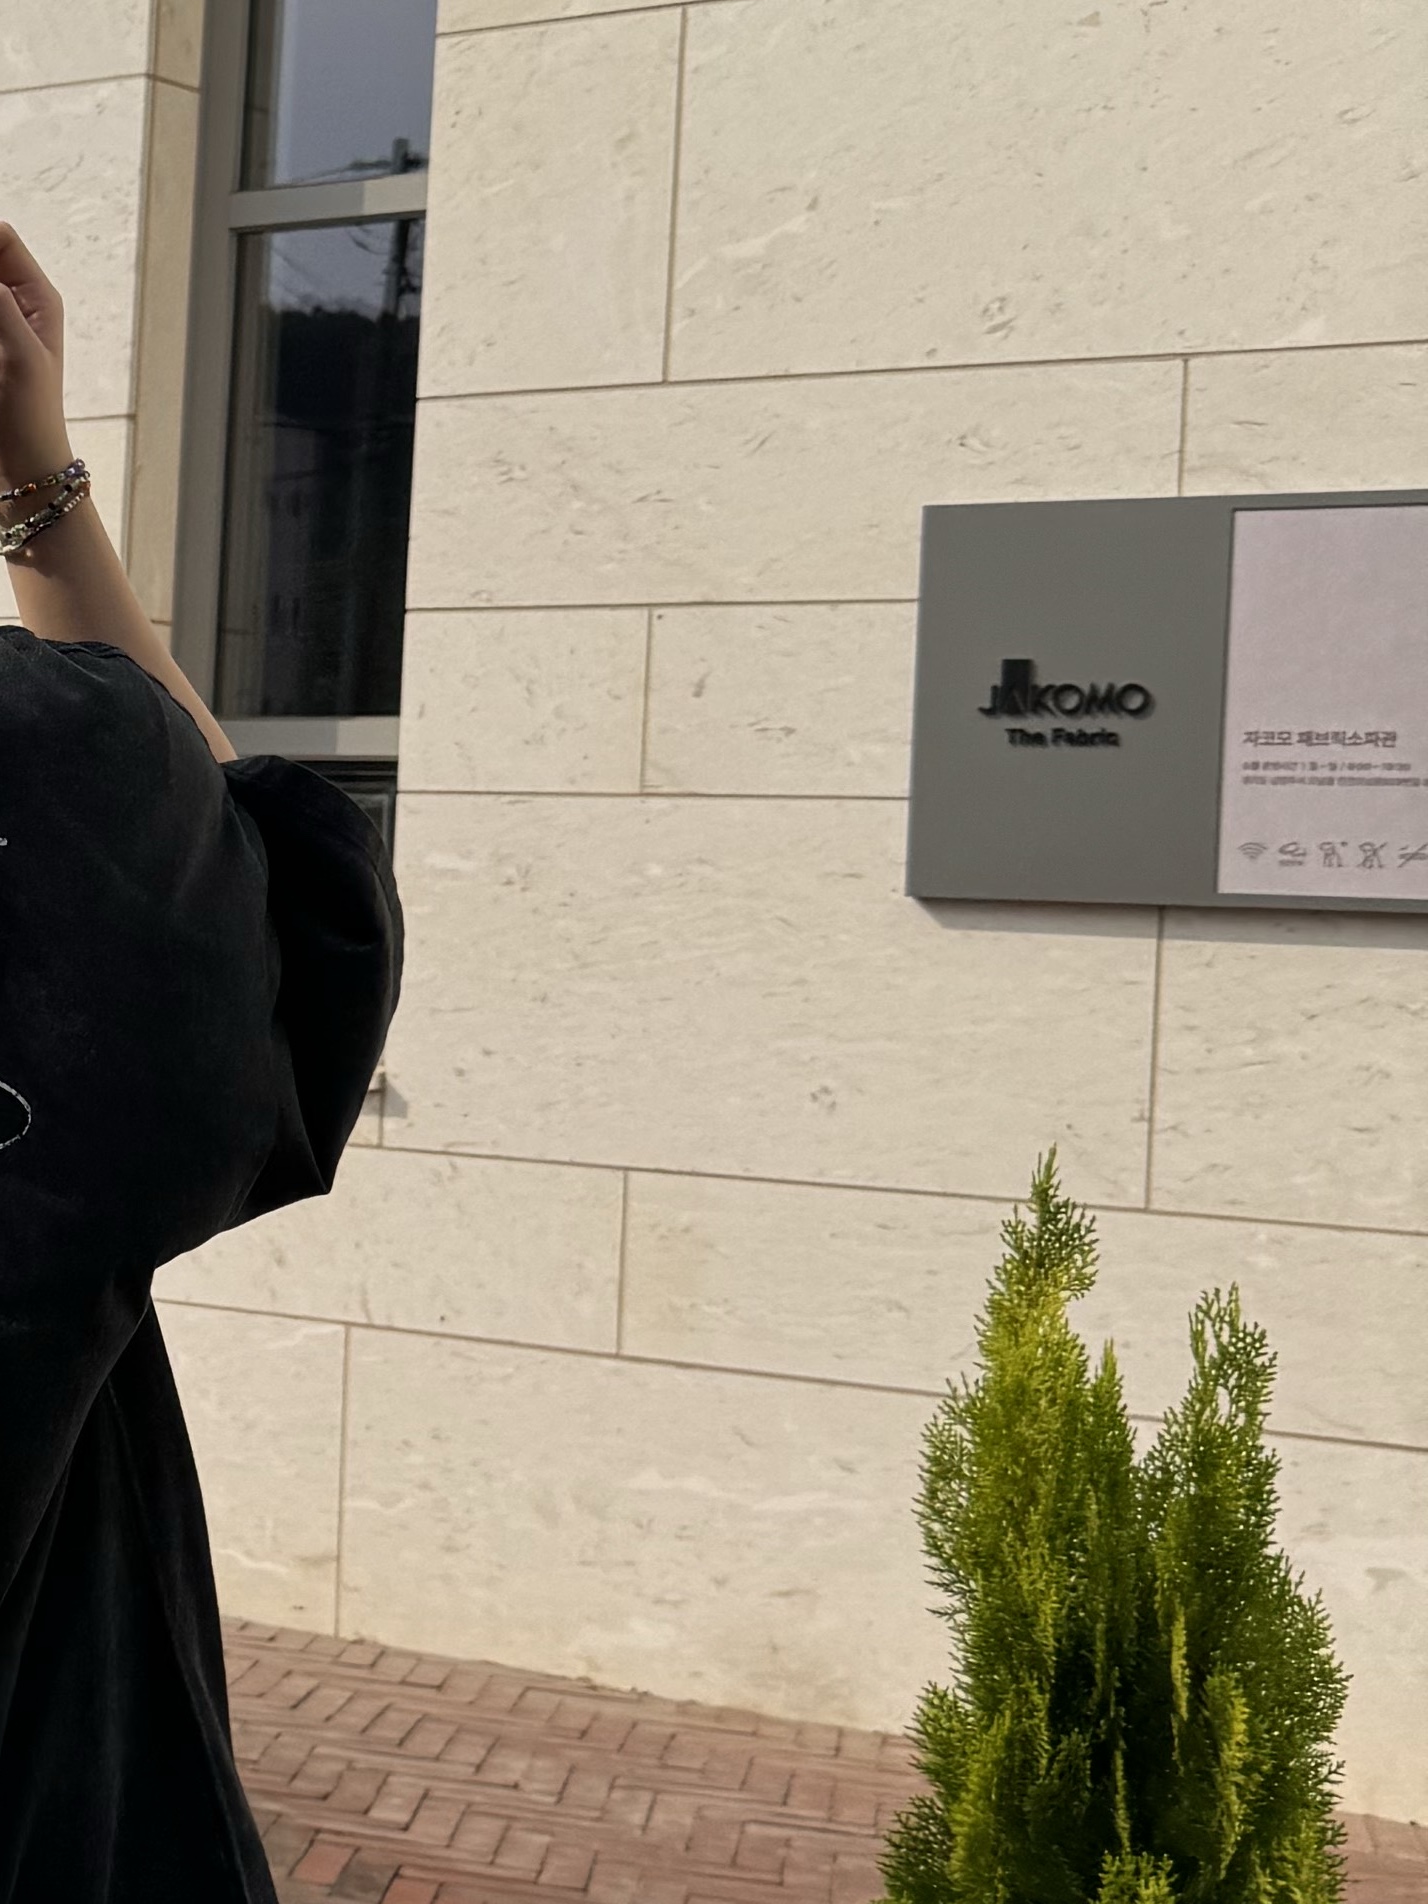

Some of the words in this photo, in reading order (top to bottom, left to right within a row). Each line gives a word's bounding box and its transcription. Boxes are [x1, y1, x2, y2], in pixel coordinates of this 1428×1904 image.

[978, 659, 1153, 716] JAKOMO
[1005, 728, 1046, 746] The
[1243, 730, 1293, 747] 자코모
